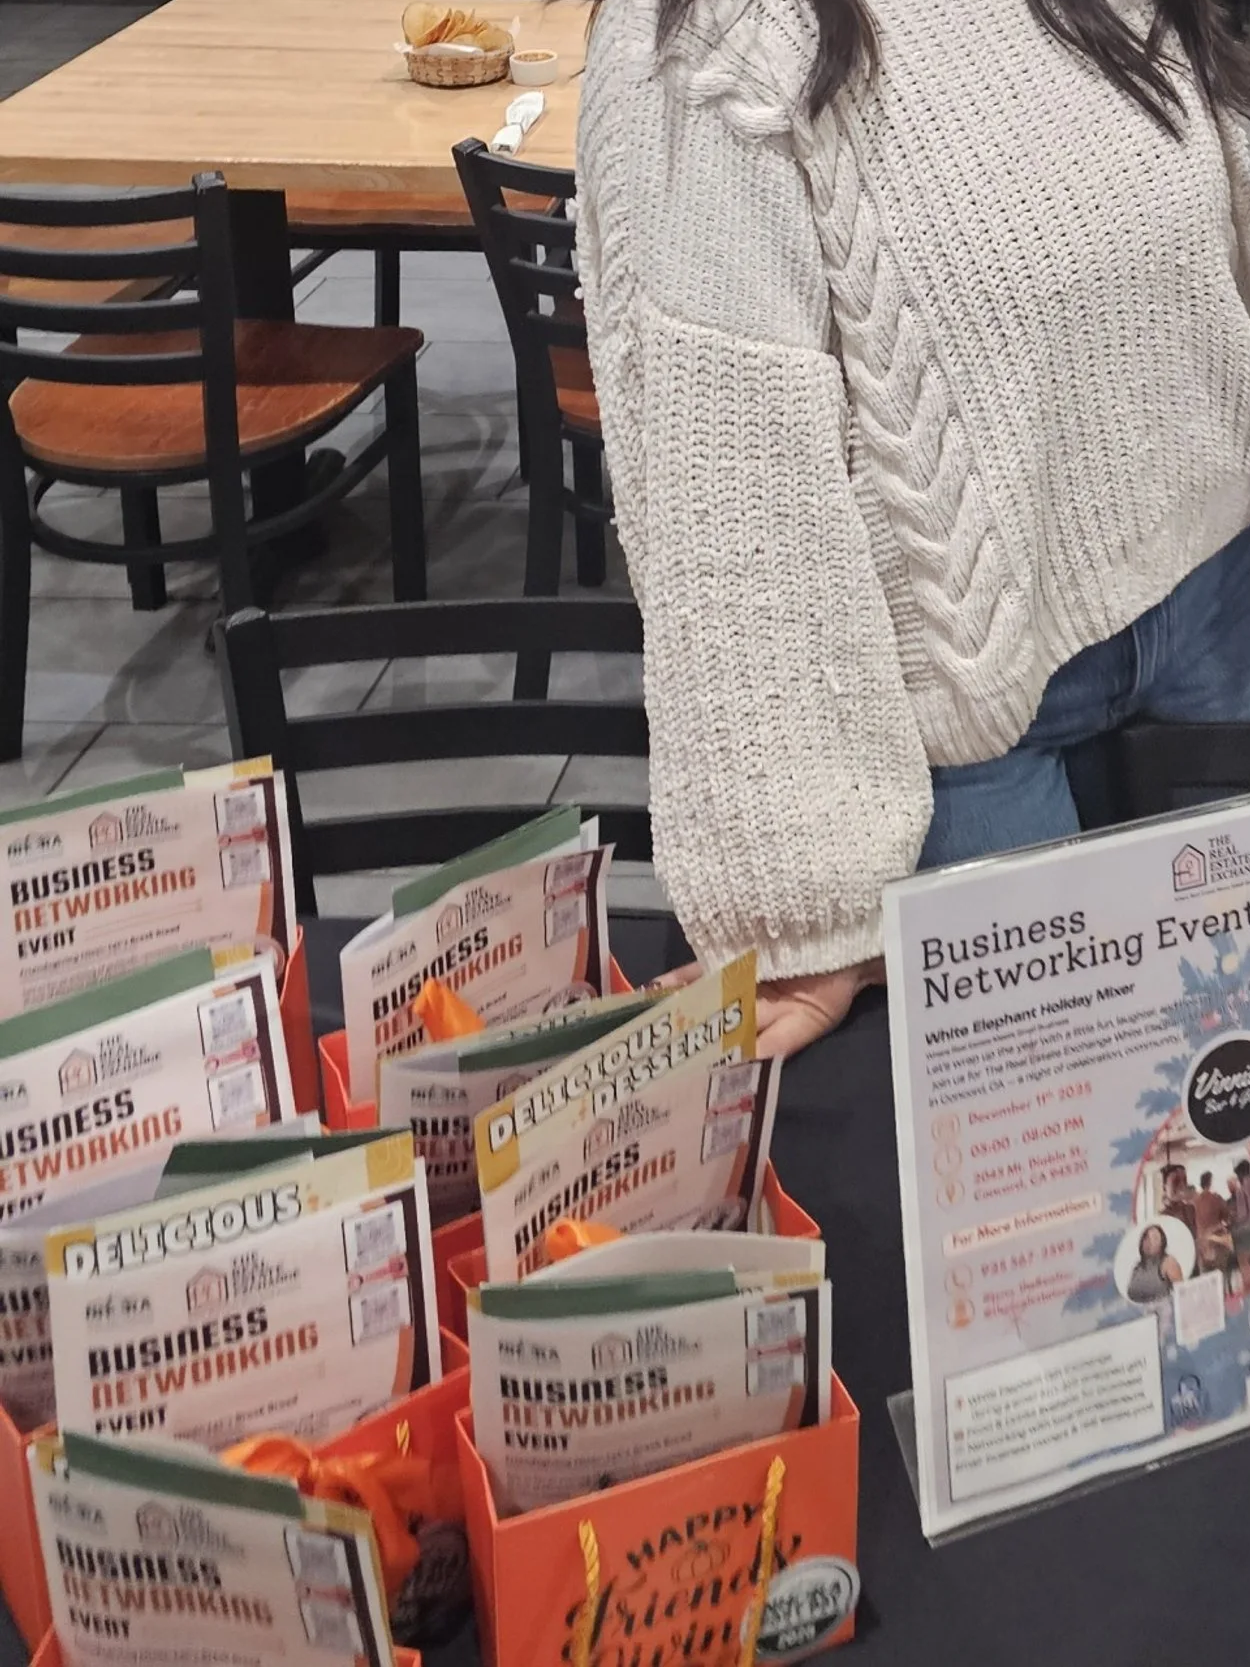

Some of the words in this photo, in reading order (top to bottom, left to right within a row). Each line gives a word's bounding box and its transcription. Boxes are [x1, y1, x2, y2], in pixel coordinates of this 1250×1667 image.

[1208, 834, 1232, 848] THE
[1209, 845, 1237, 859] REAL
[1210, 852, 1250, 872] ESTATE
[10, 847, 156, 907] BUSINESS
[14, 866, 196, 933] NETWORKING
[18, 925, 77, 959] EVENT
[922, 910, 1086, 971] Business
[924, 932, 1144, 1008] Networking
[373, 926, 489, 1022] BUSINESS
[925, 1024, 969, 1046] White
[973, 1007, 1037, 1032] Elephant
[1041, 993, 1093, 1015] Holiday
[1096, 982, 1135, 1001] Mixer
[489, 1011, 673, 1154] DELICIOUS
[592, 999, 743, 1119] DESSERTS
[968, 1102, 1030, 1126] December
[515, 1142, 640, 1255] BUSINESS
[64, 1182, 300, 1282] DELICIOUS
[88, 1304, 268, 1379] BUSINESS
[91, 1321, 319, 1412] NETWORKING
[500, 1365, 669, 1404] BUSINESS
[503, 1380, 716, 1432] NETWORKING
[504, 1431, 570, 1452] EVENT
[626, 1501, 760, 1570] HAPPY
